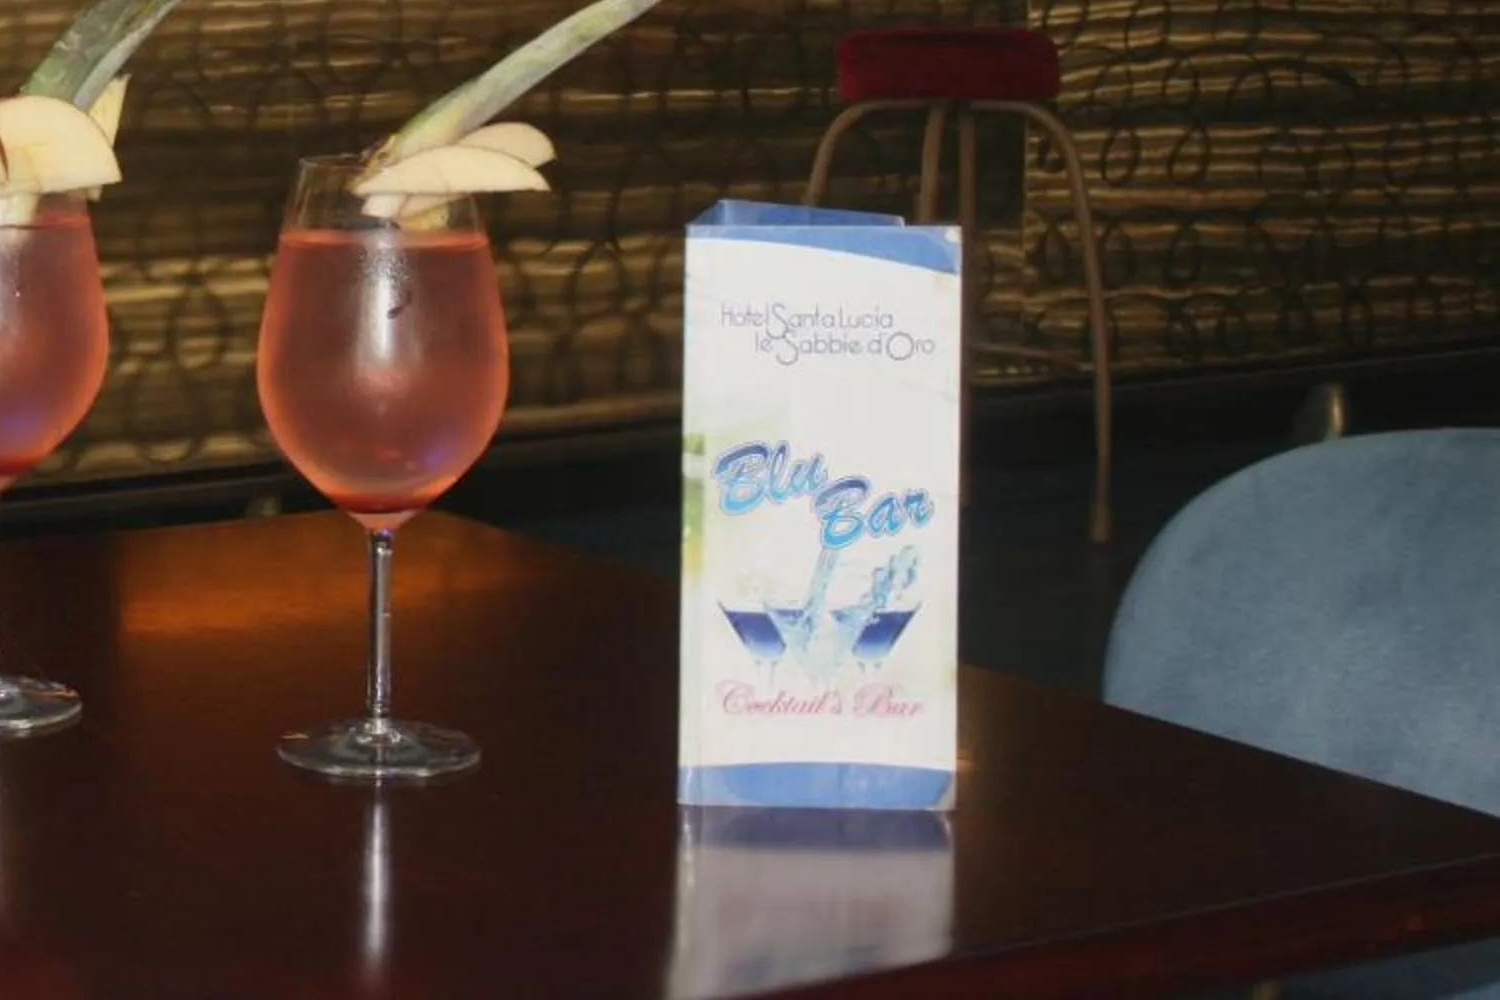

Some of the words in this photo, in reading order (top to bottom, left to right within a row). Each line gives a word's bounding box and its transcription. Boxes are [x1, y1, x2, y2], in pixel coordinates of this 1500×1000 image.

[720, 302, 769, 328] Hotel
[766, 302, 835, 340] Santa
[838, 304, 893, 329] Lucia
[776, 328, 862, 365] Sabbie
[712, 441, 827, 515] Blu
[812, 475, 934, 550] Bar
[851, 681, 925, 718] Bar
